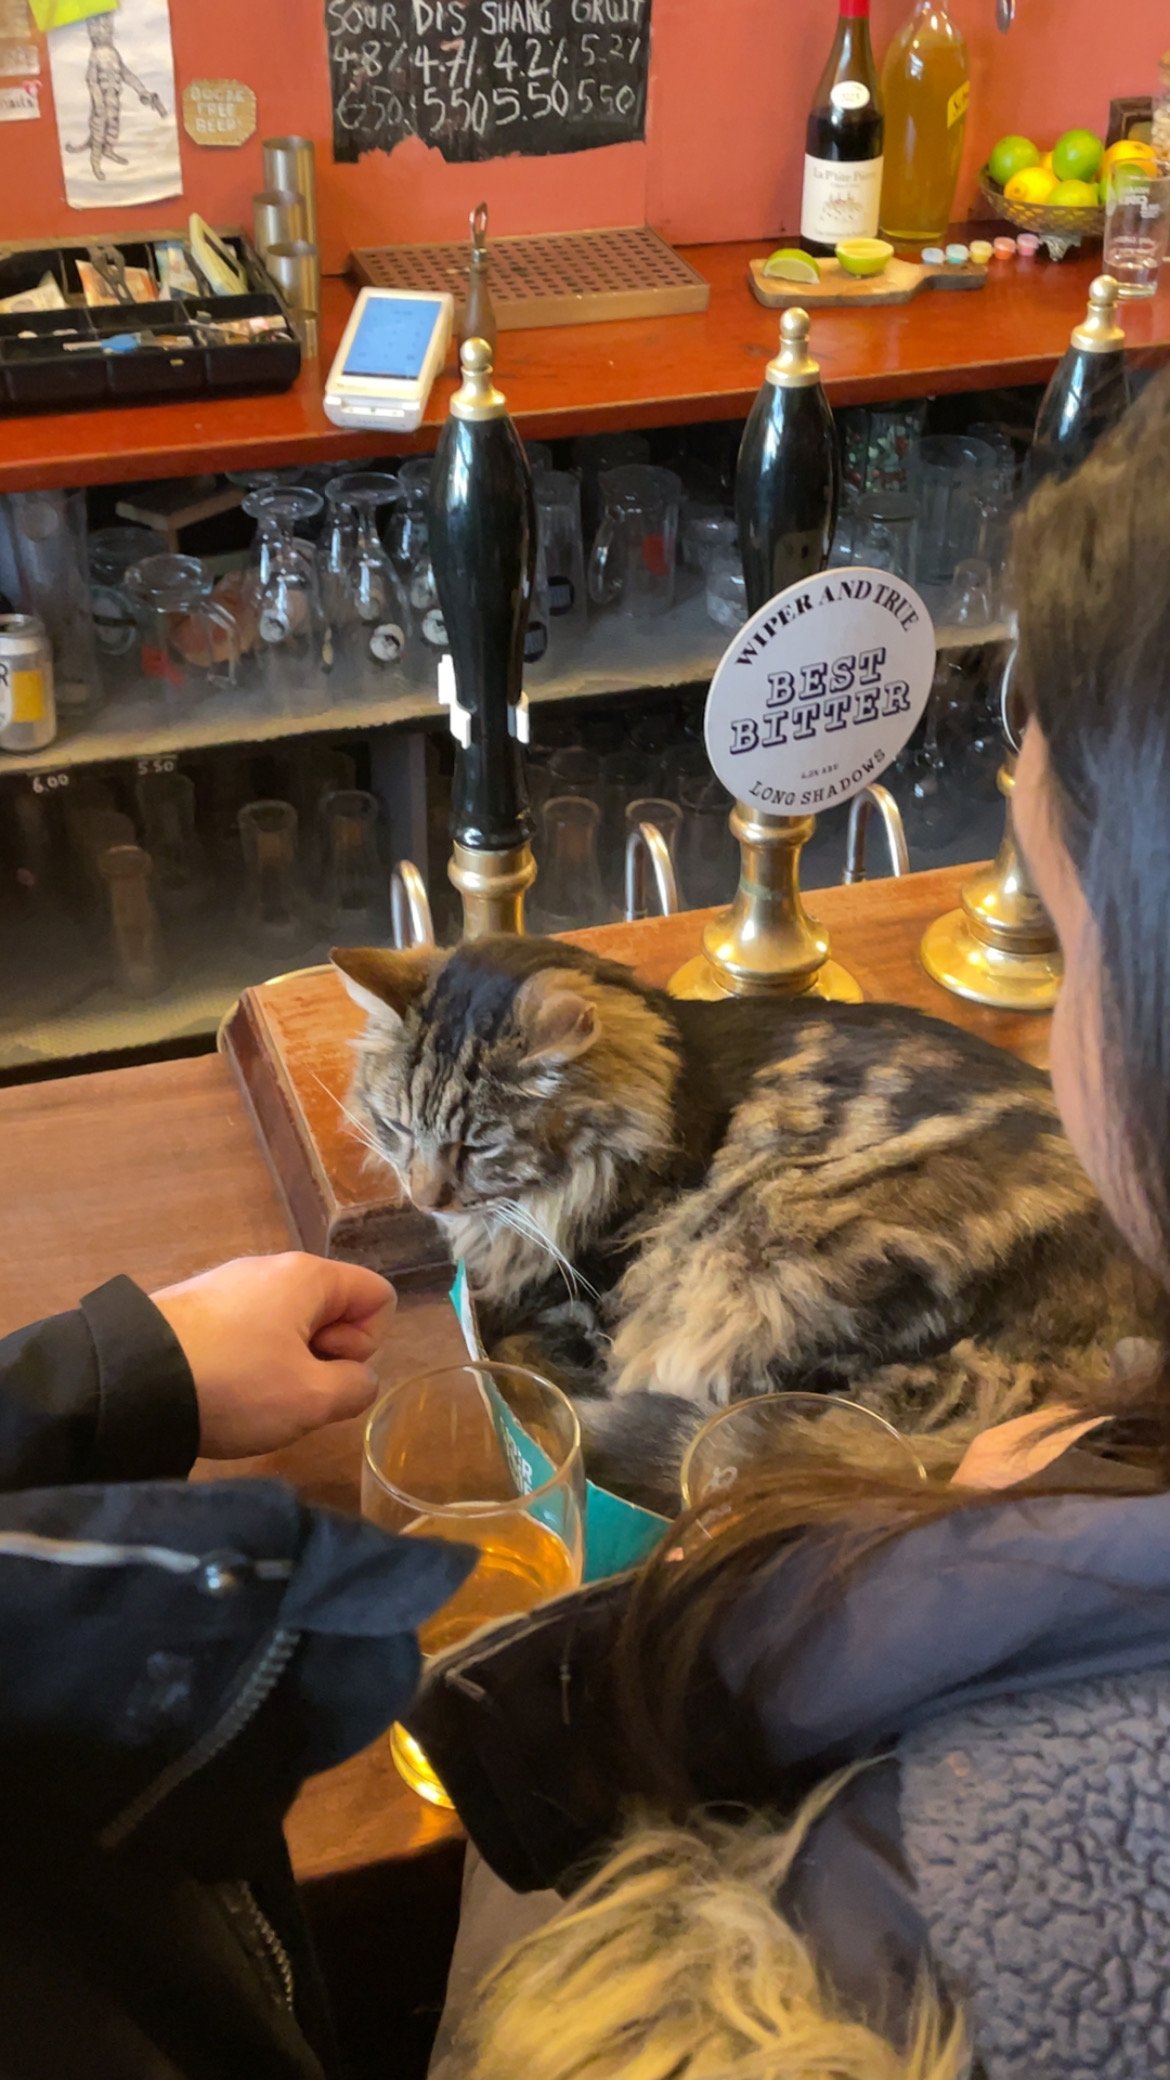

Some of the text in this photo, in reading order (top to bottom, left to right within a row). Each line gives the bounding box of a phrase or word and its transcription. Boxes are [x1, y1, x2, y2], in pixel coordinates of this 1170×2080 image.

[327, 0, 401, 37] SOUR
[413, 0, 466, 36] DIS
[492, 80, 569, 125] 5.50
[735, 580, 919, 665] WIPER AND TRUE
[766, 647, 886, 708] BEST
[730, 680, 911, 755] BITTER
[749, 748, 885, 806] LONG SHADOWS
